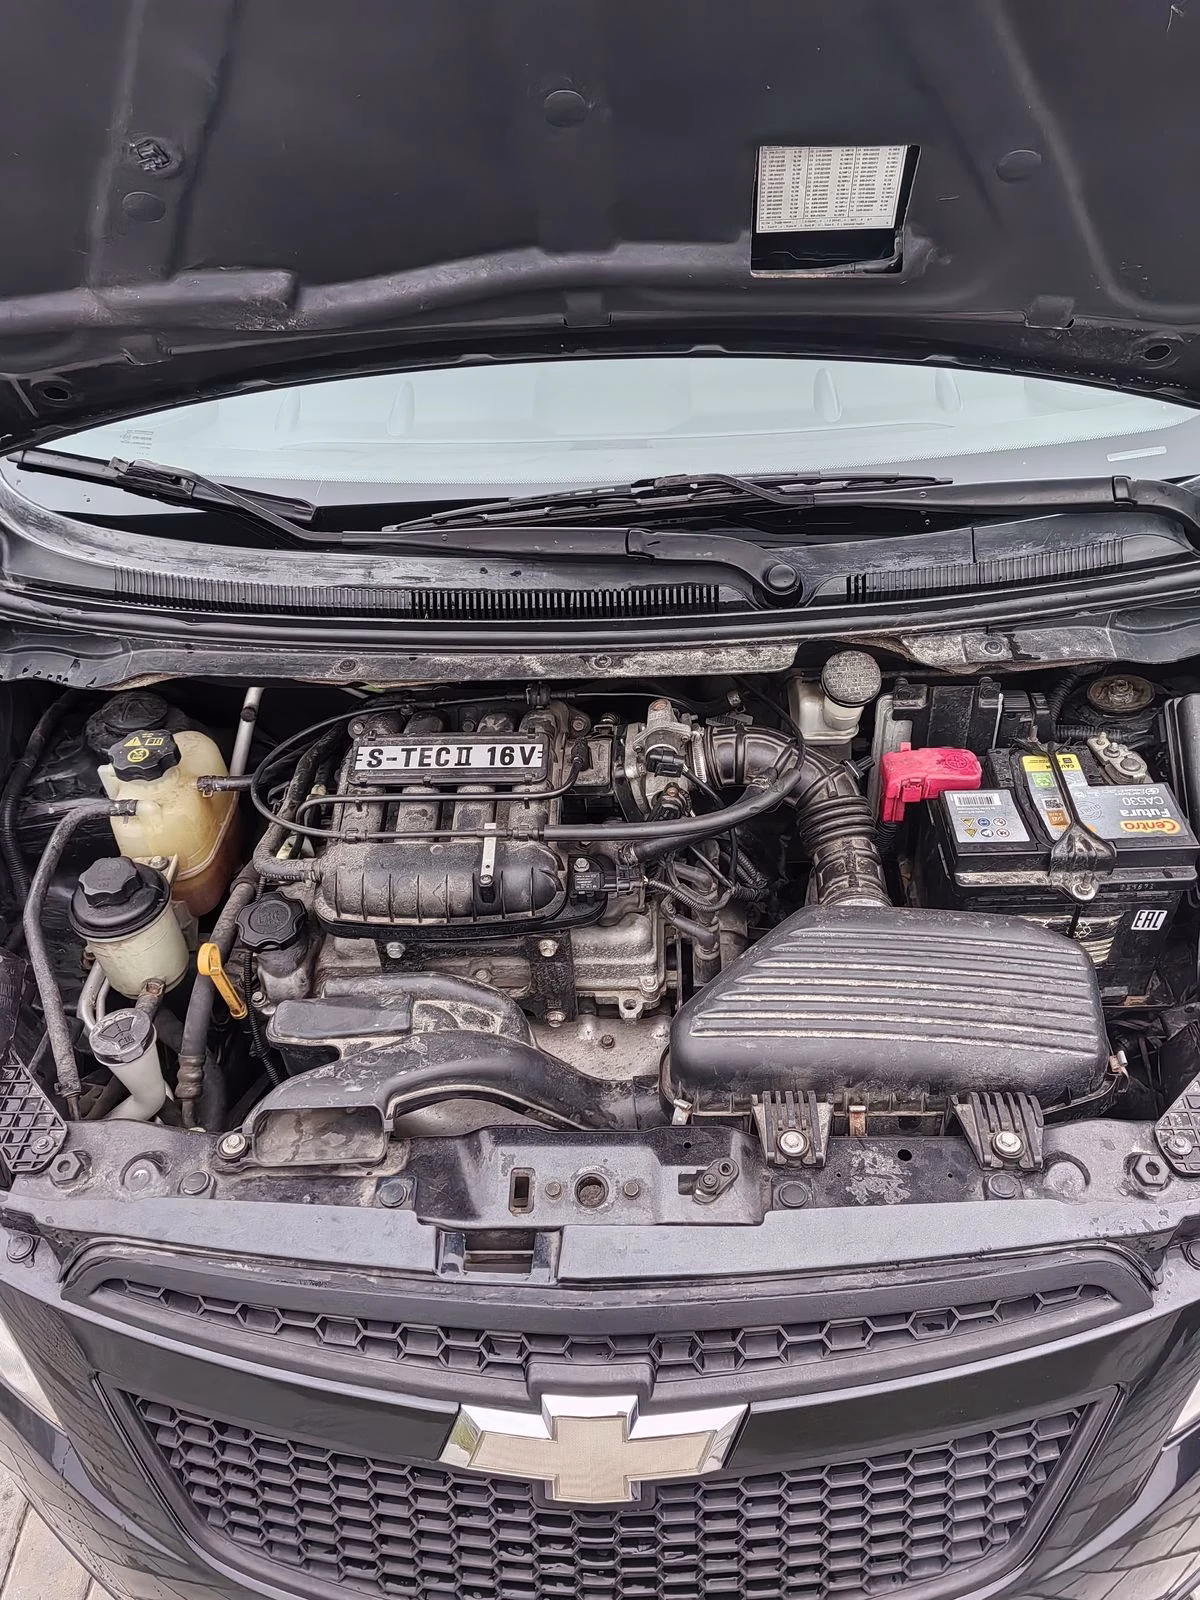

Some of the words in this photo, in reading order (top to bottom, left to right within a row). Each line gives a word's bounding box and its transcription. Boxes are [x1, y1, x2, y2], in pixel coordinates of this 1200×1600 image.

[487, 746, 537, 766] 16V
[1122, 796, 1165, 806] CA530
[1120, 808, 1171, 817] Futura
[1124, 820, 1176, 832] Centra
[1133, 911, 1165, 929] EAC
